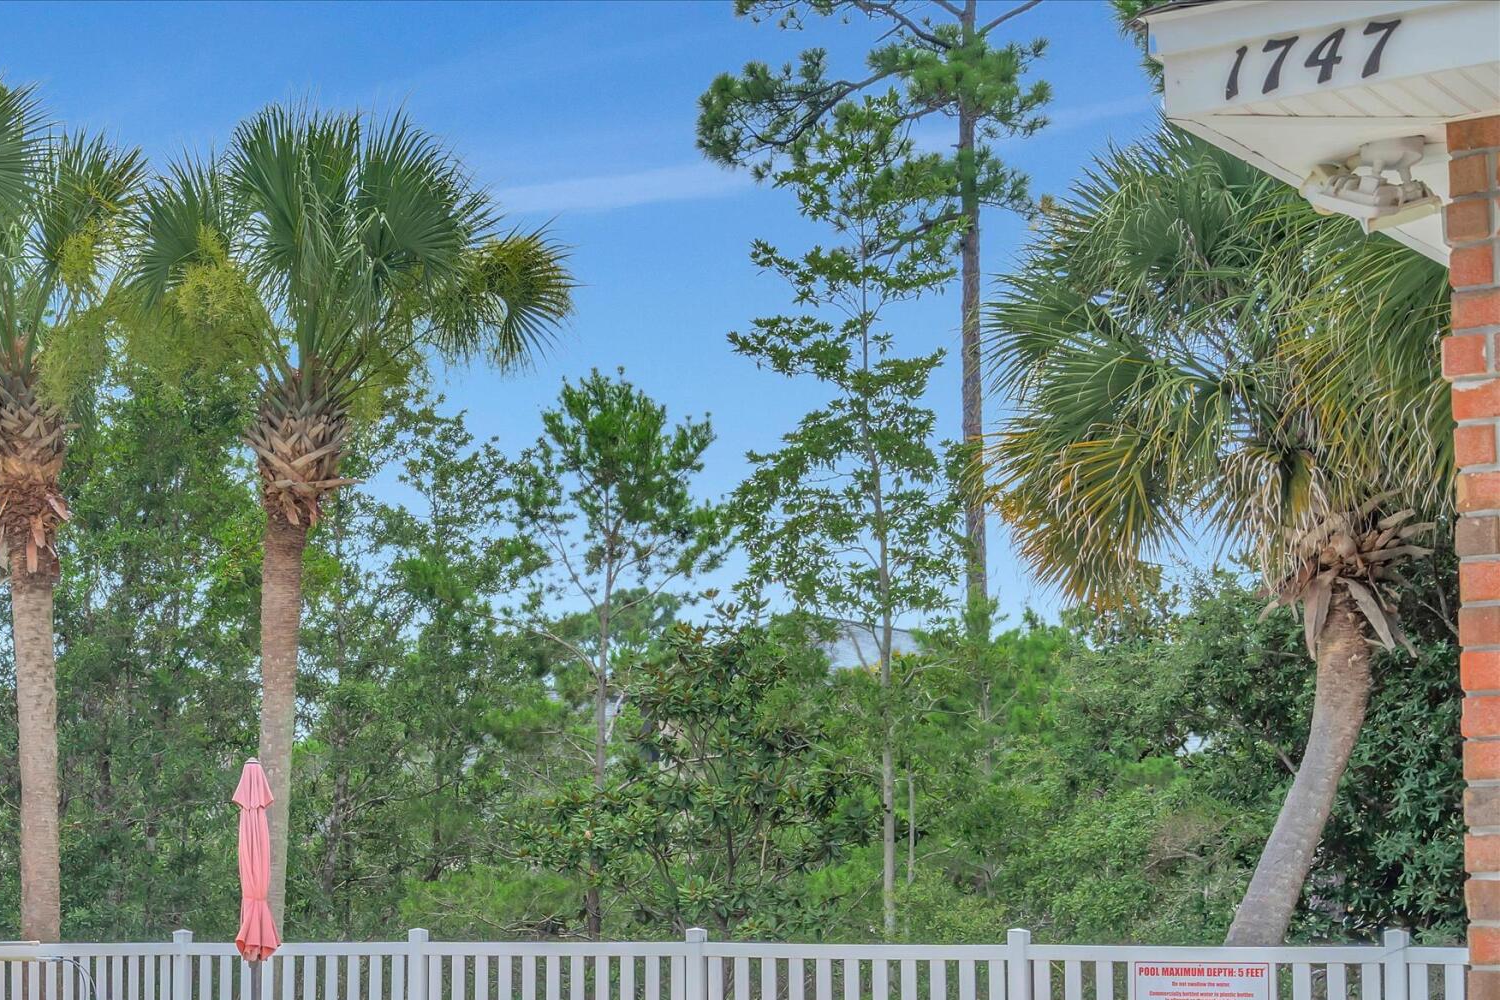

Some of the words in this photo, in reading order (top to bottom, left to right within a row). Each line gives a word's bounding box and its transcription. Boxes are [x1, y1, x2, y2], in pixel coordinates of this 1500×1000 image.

[1225, 19, 1402, 100] 1747
[1138, 966, 1160, 976] POOL
[1162, 967, 1205, 977] MAXIMUM
[1207, 967, 1236, 977] DEPTH:
[1238, 968, 1245, 977] 5
[1246, 968, 1265, 978] FEET
